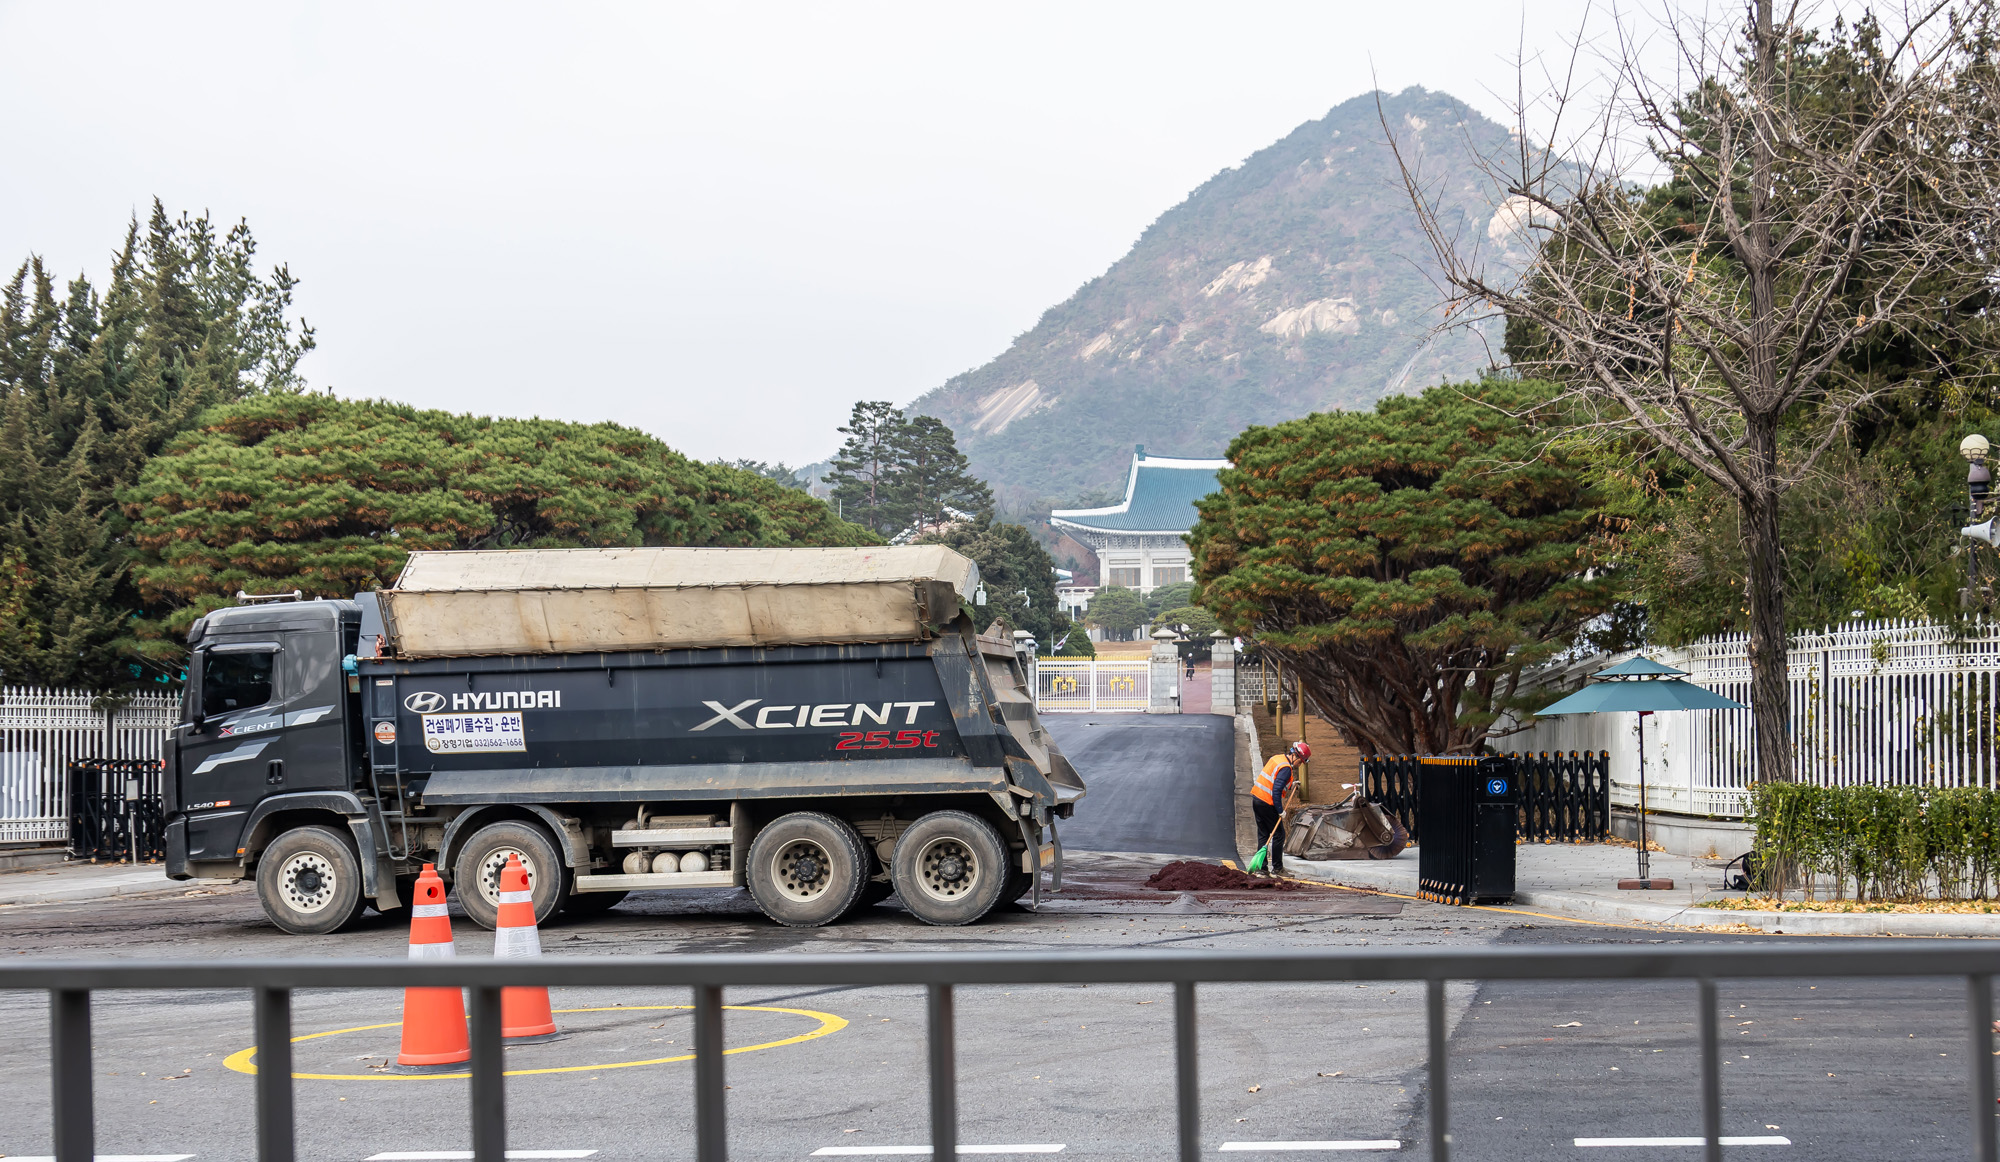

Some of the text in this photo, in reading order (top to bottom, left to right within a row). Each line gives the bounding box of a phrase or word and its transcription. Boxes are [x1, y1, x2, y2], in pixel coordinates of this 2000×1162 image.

[452, 690, 561, 711] HYUNDAI
[688, 698, 936, 731] XCIENT
[218, 721, 277, 738] XCIENT
[836, 730, 940, 751] 25.5t
